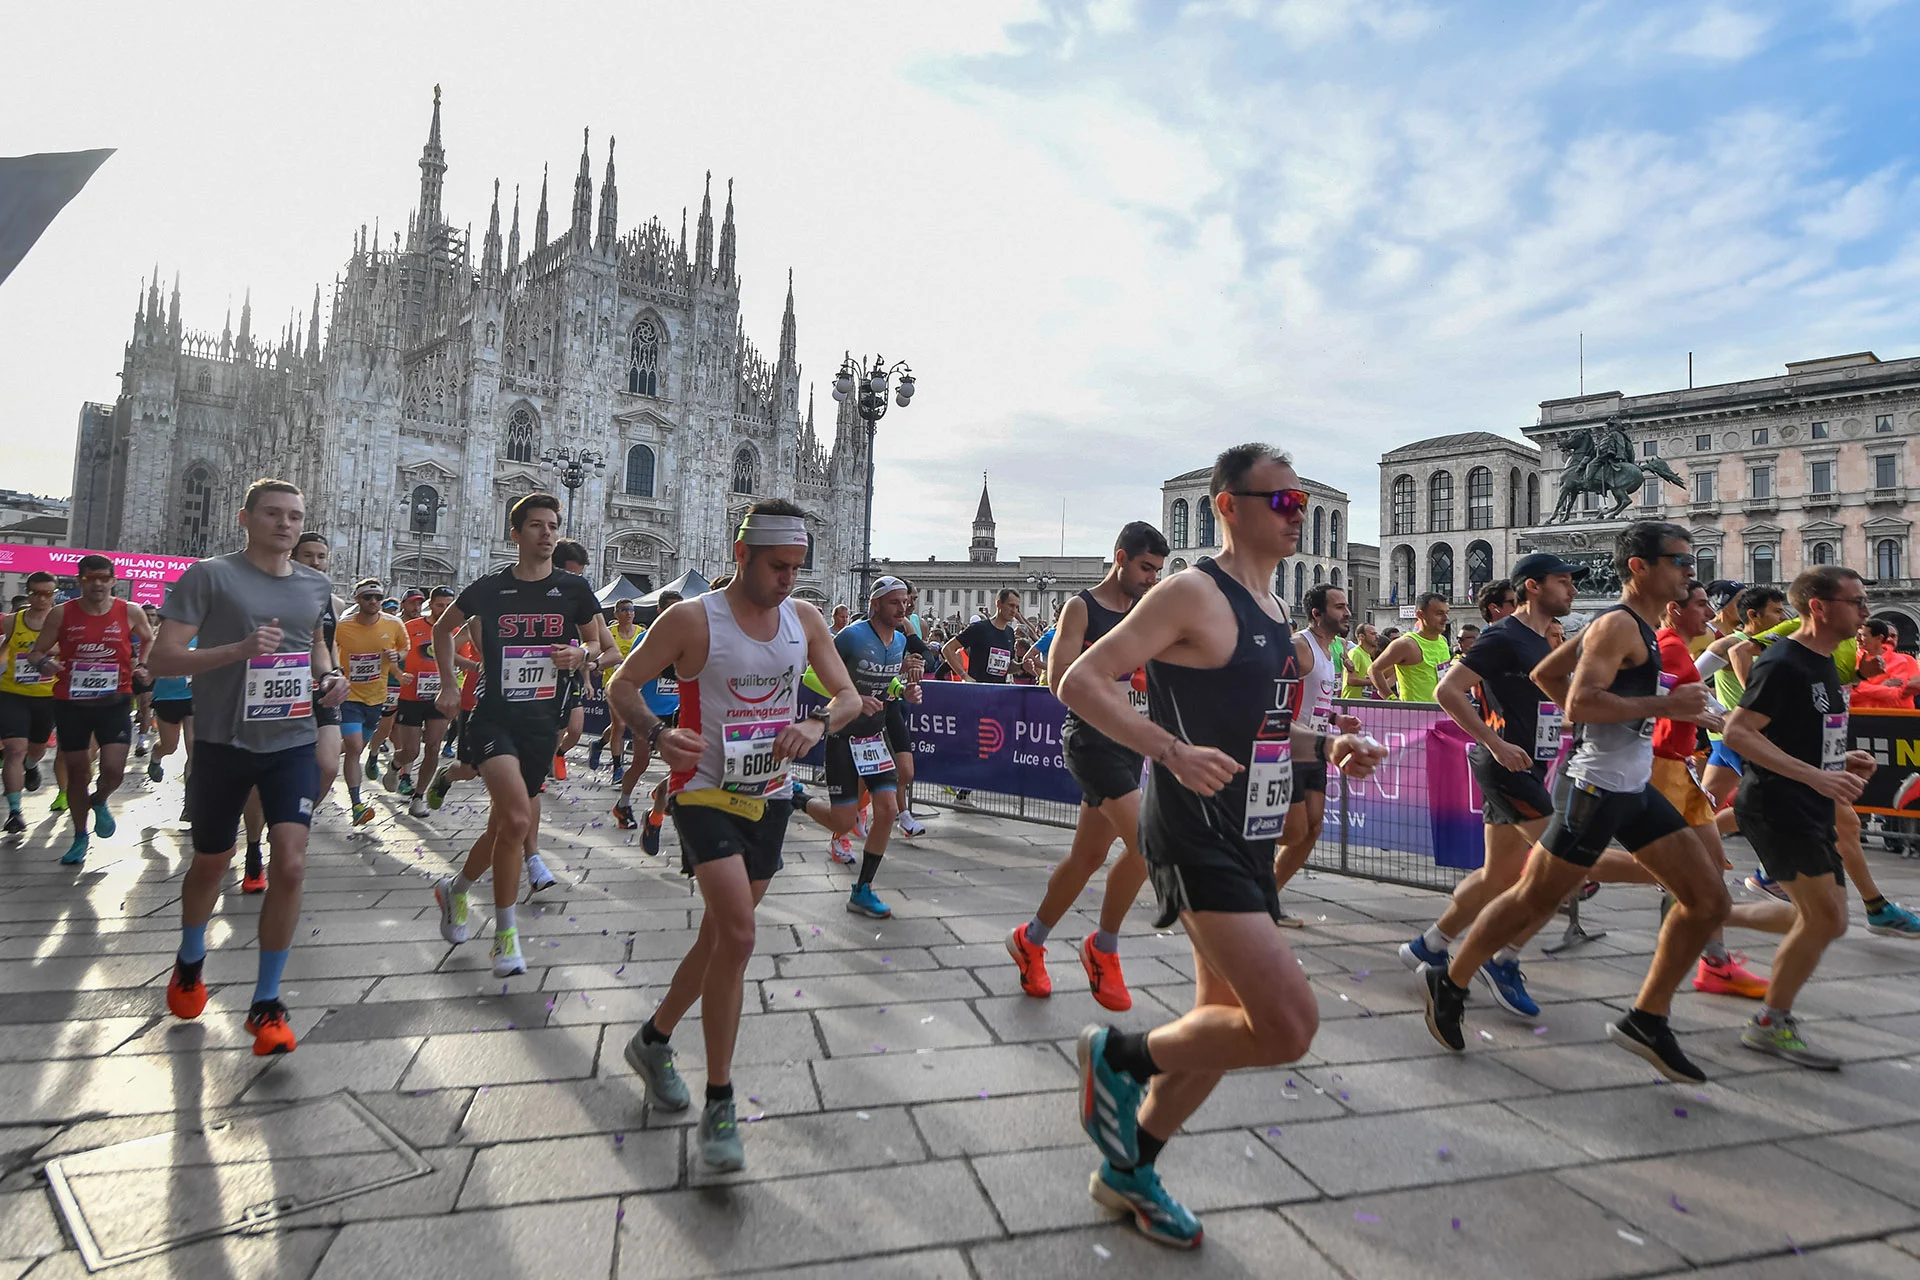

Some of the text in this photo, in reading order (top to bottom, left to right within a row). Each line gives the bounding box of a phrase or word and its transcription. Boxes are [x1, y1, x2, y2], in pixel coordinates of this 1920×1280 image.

[115, 557, 164, 569] MILANO
[125, 569, 165, 580] START
[498, 613, 564, 638] STB
[518, 667, 544, 684] 3177
[264, 679, 301, 698] 3586
[918, 741, 936, 753] Gas
[863, 749, 880, 761] 4911
[1013, 750, 1039, 766] Luce
[1042, 756, 1050, 767] e
